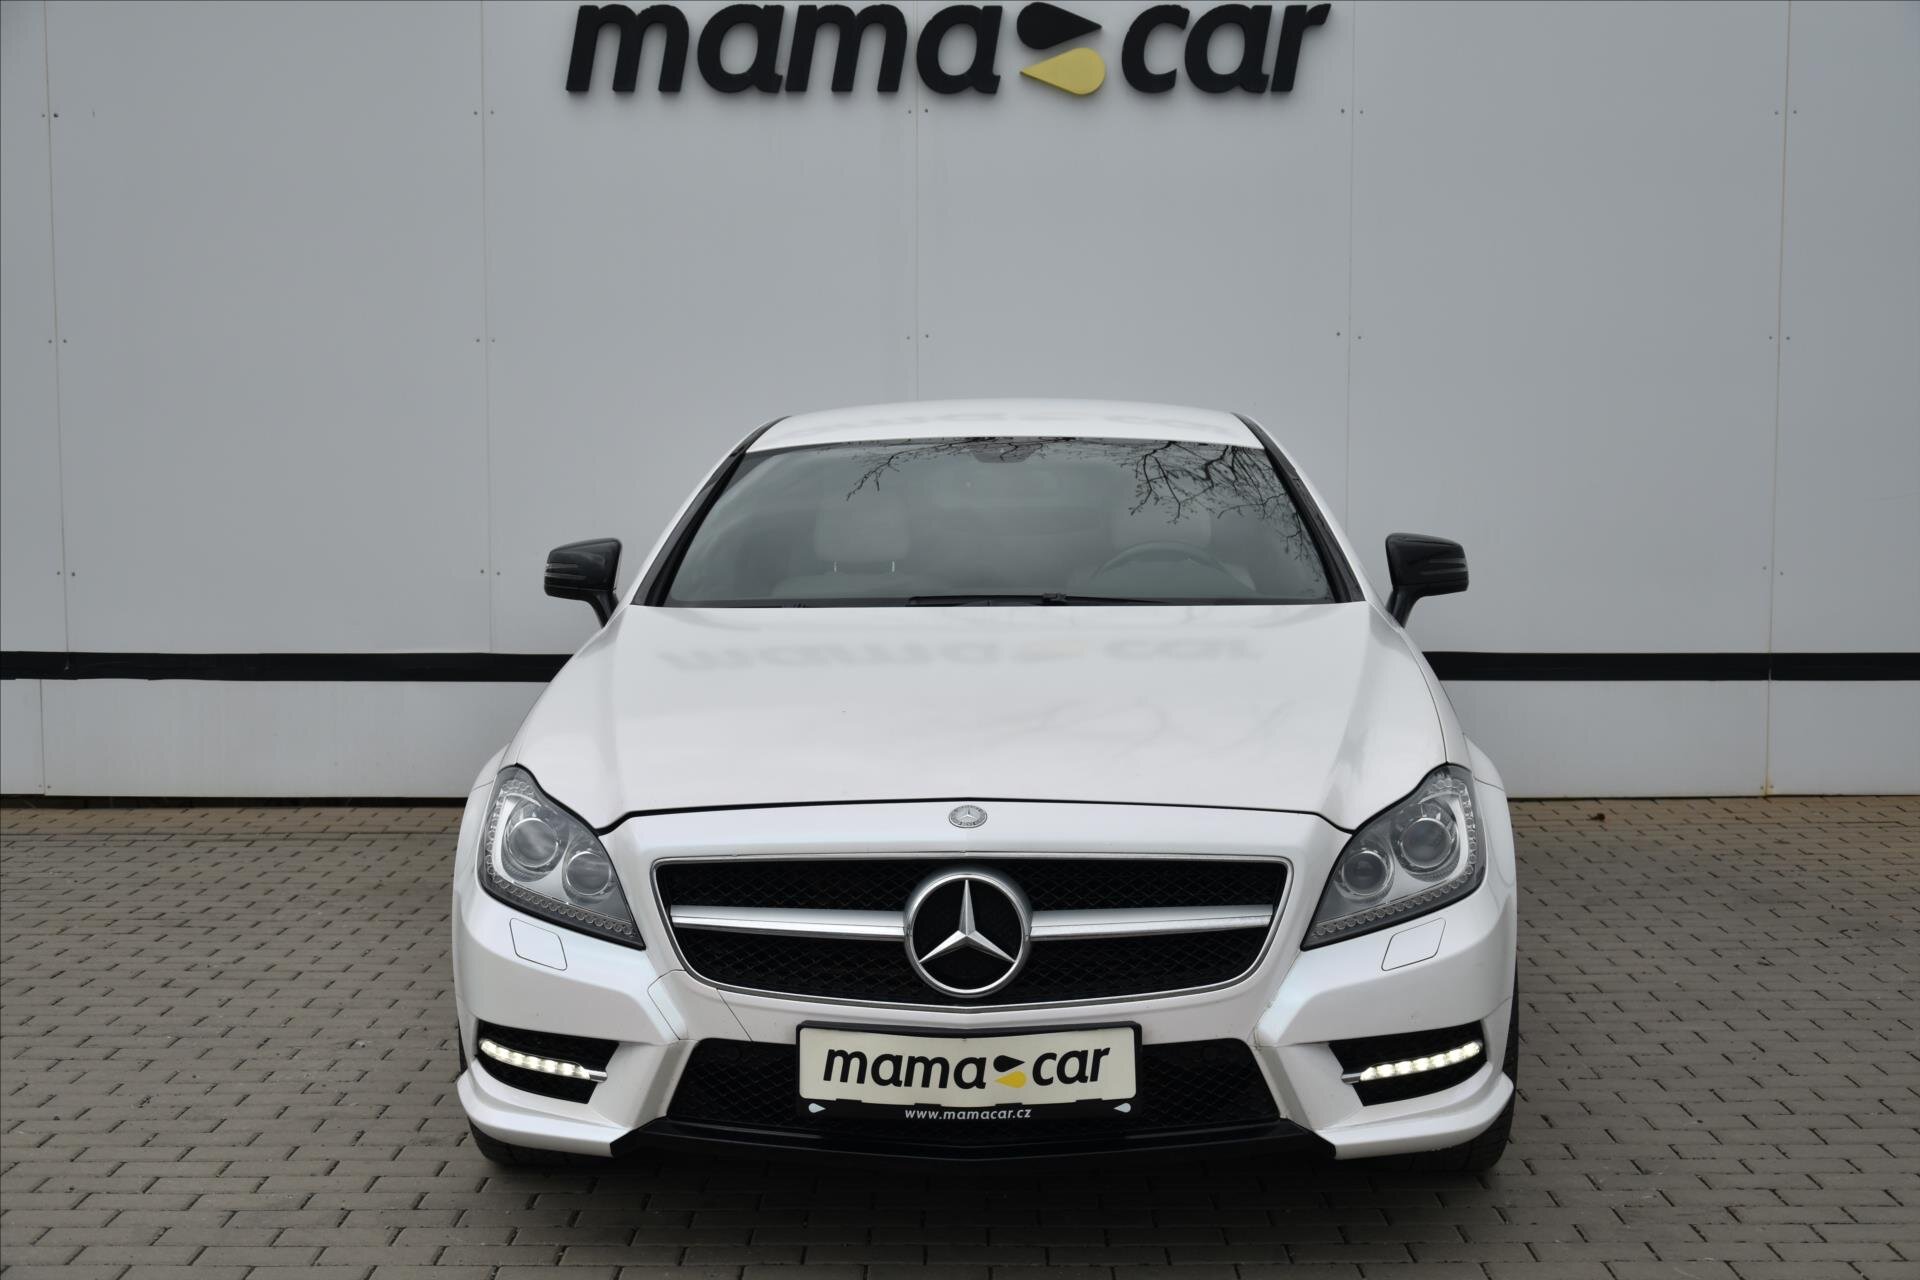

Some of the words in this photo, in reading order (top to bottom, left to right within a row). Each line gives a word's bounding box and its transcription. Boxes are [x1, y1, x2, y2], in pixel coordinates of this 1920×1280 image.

[565, 3, 1002, 95] mama
[1121, 2, 1331, 95] car
[823, 1048, 987, 1090] mama
[1032, 1047, 1110, 1086] car
[904, 1108, 1032, 1121] www.mamacar.cz
